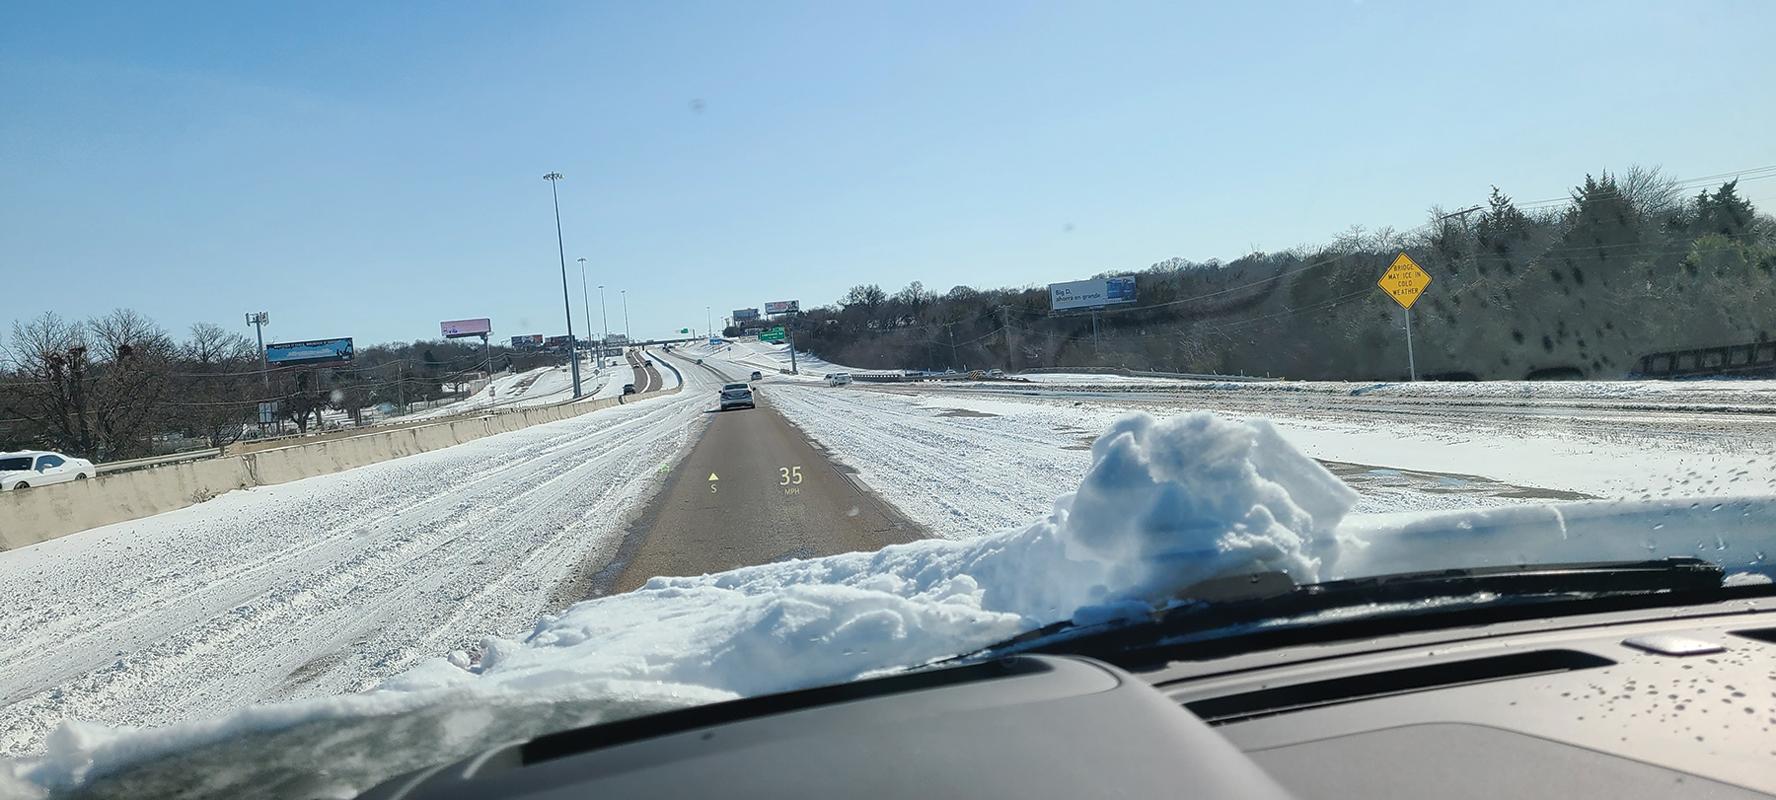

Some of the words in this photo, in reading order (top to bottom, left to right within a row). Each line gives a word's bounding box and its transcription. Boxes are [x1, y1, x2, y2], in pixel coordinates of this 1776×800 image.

[779, 466, 803, 486] 35
[710, 484, 717, 493] S
[784, 487, 800, 495] MPH
